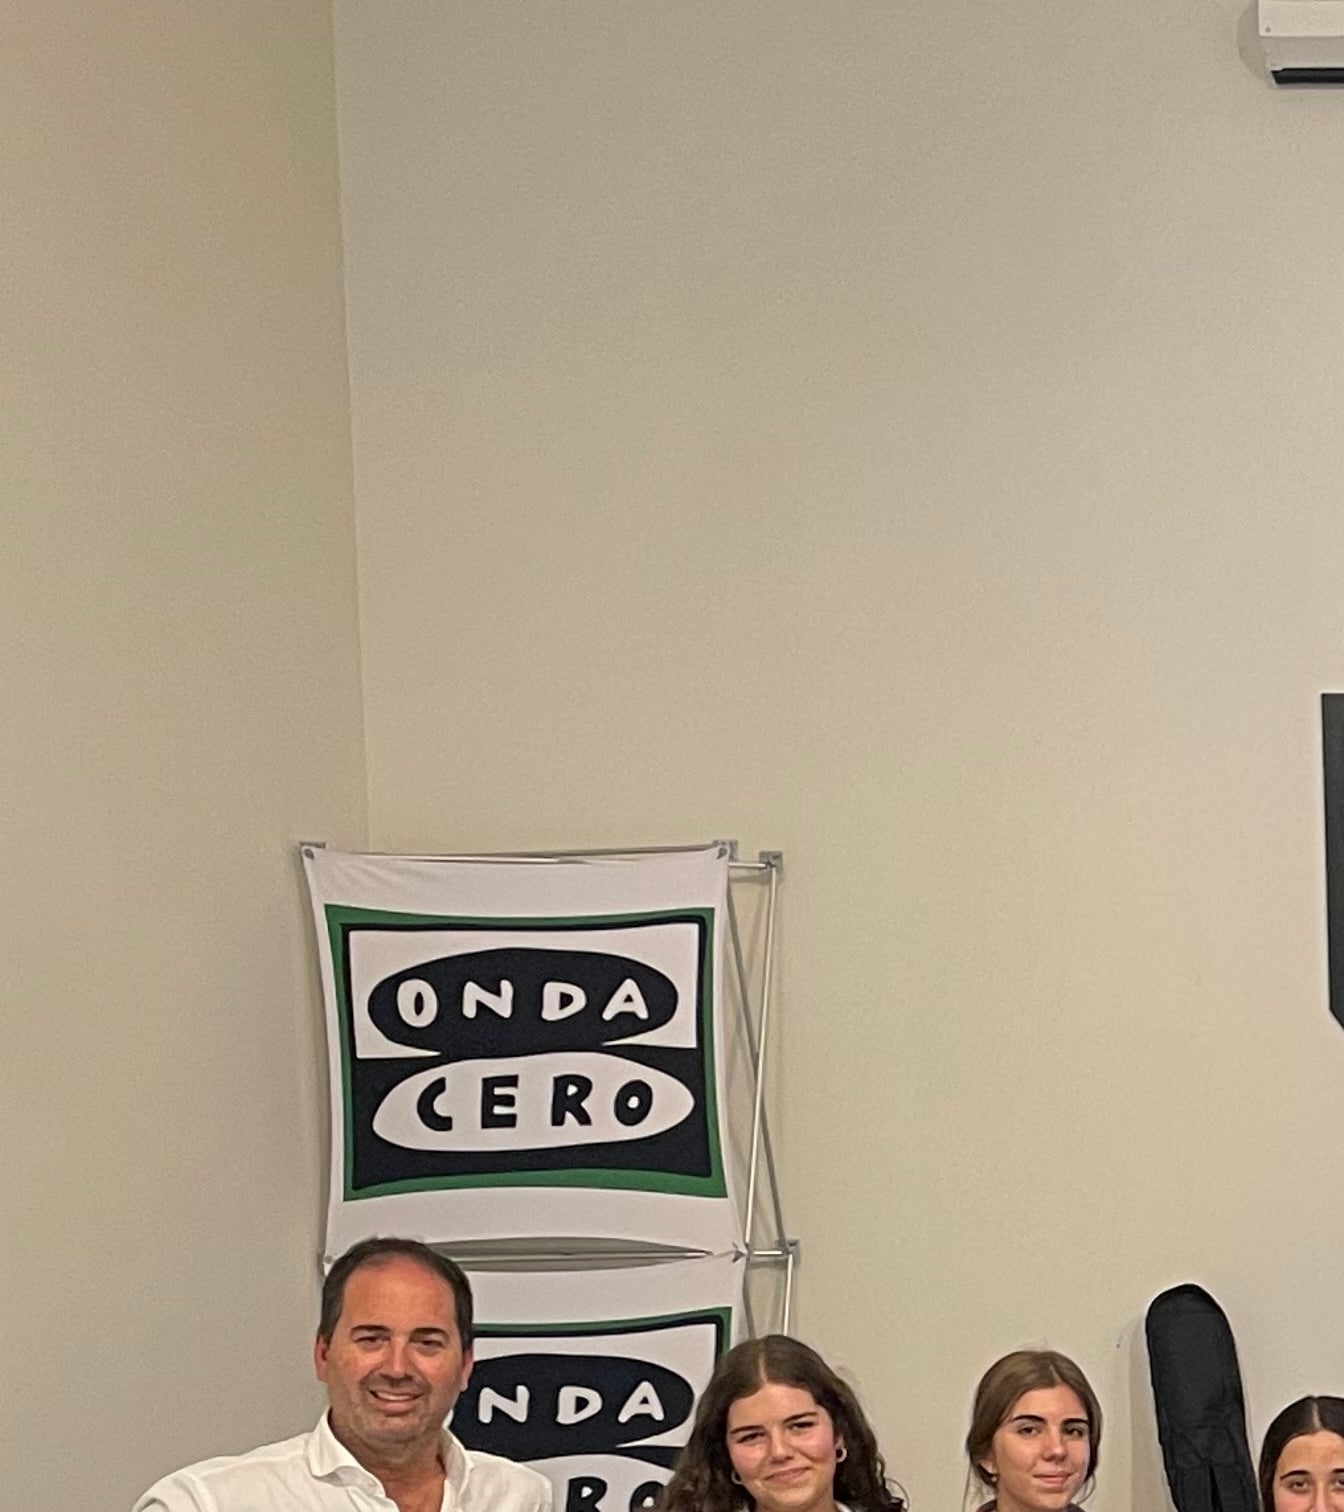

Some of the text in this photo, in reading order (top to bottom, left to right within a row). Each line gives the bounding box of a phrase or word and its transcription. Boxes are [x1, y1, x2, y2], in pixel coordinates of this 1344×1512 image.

[397, 978, 650, 1028] ONDA
[416, 1073, 654, 1133] CERO
[478, 1380, 665, 1425] NDA
